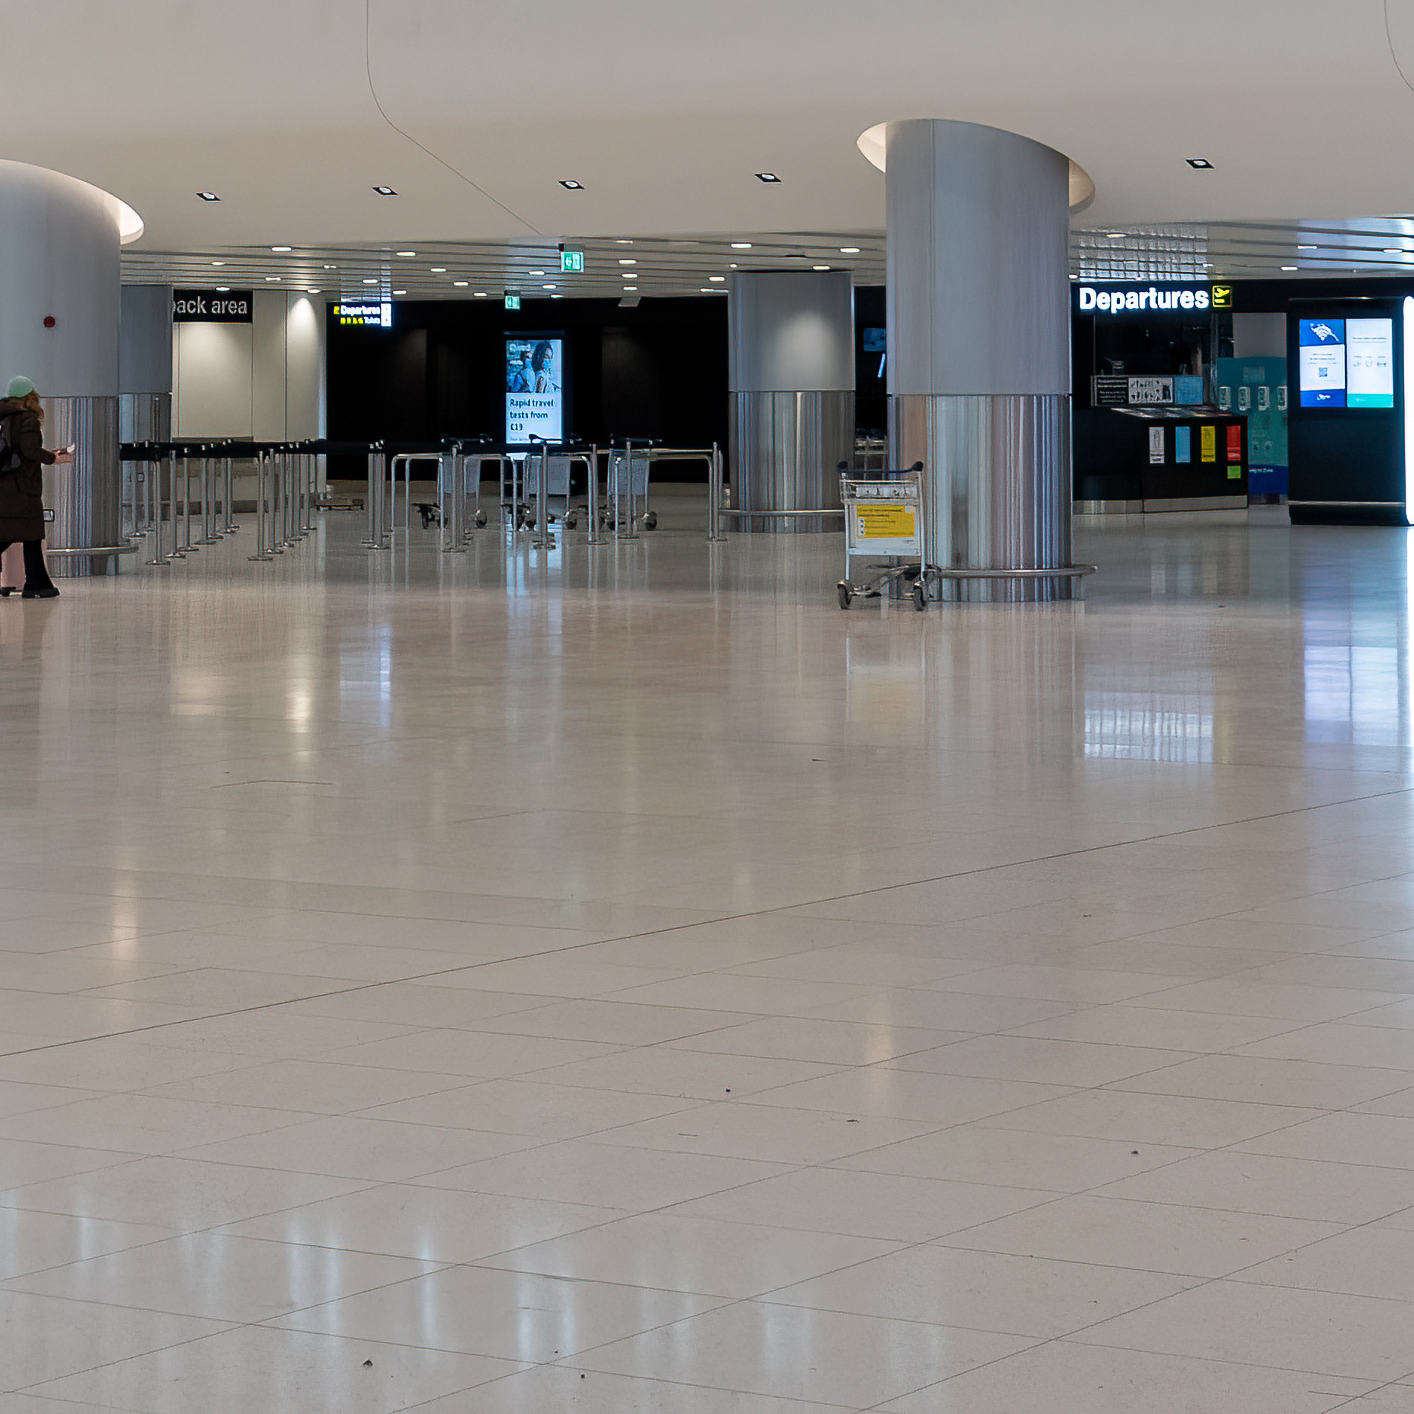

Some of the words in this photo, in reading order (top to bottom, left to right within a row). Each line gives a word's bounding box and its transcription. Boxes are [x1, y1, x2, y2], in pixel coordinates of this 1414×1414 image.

[1079, 286, 1210, 314] Departures
[211, 300, 248, 315] area
[509, 398, 531, 408] Rapid
[532, 398, 554, 407] travel
[509, 411, 529, 419] tests
[530, 410, 549, 419] from
